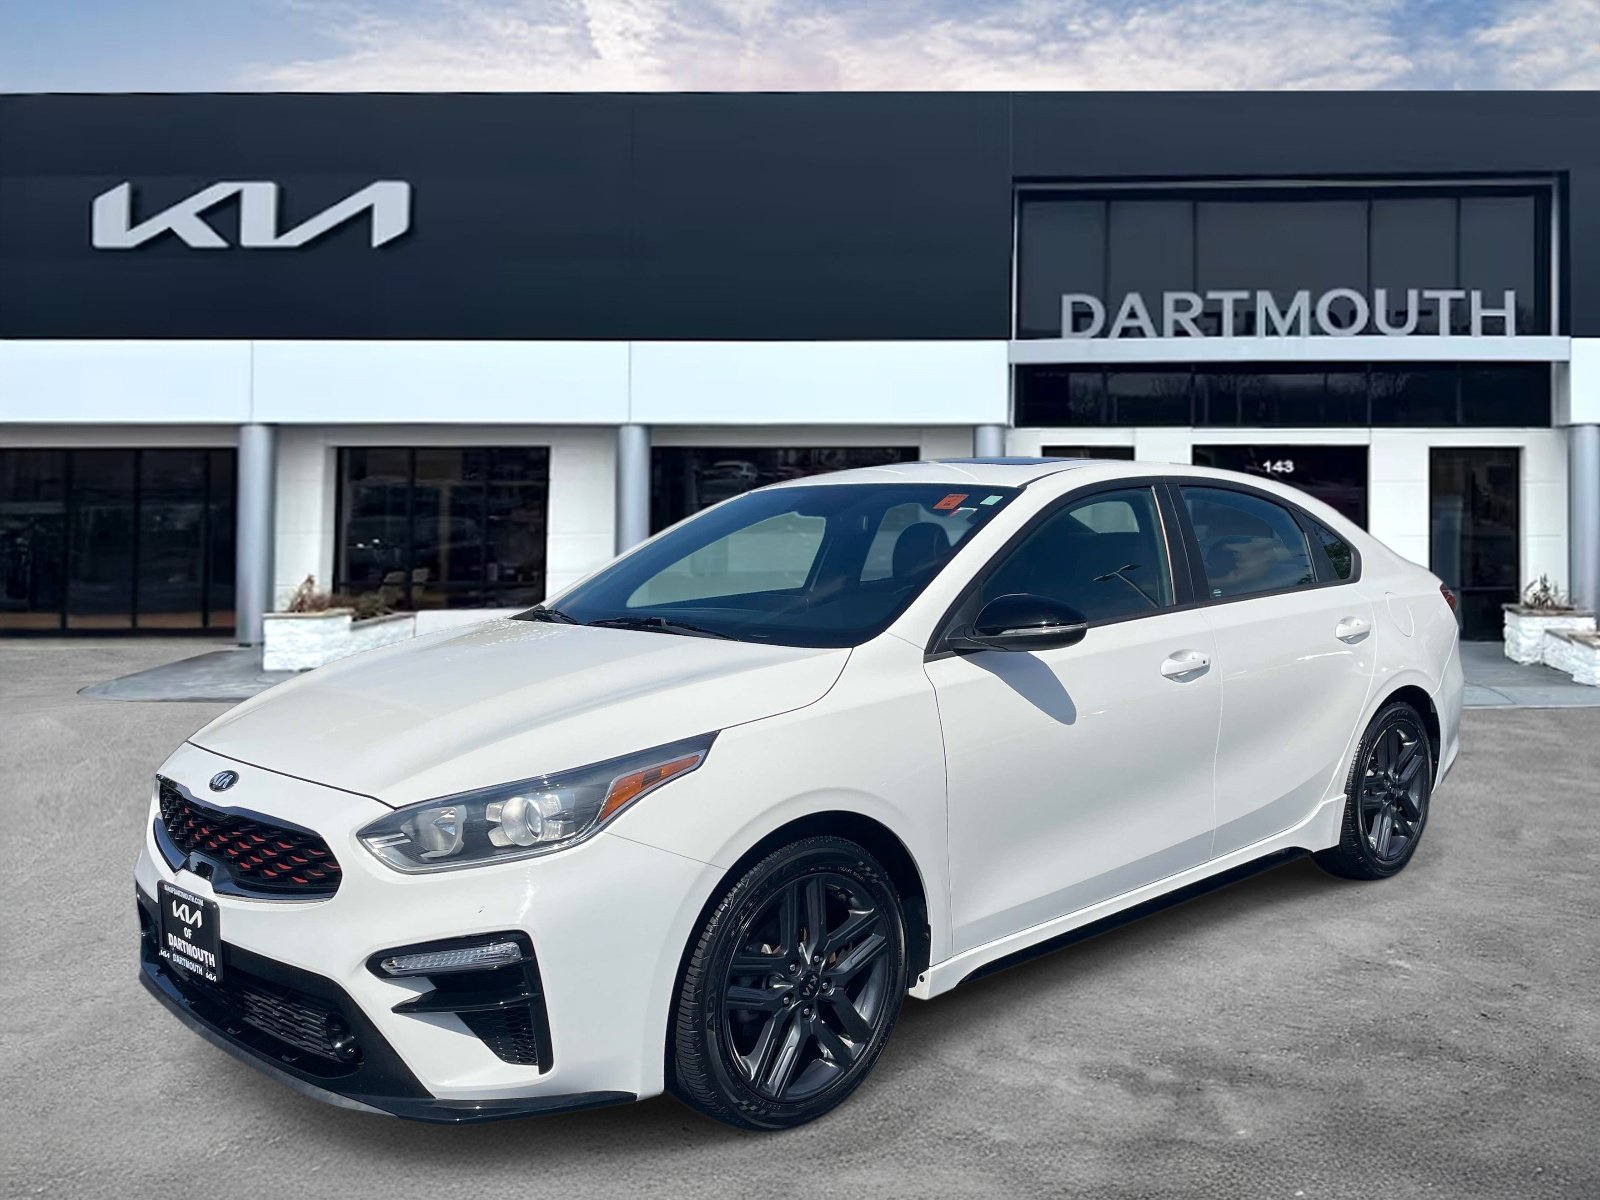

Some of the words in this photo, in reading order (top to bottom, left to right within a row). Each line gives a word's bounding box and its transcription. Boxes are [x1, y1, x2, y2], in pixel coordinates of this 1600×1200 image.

[91, 180, 412, 249] KIA
[1061, 287, 1518, 340] DARTMOUTH
[1262, 459, 1295, 474] 143
[212, 772, 233, 788] KIA
[172, 899, 203, 929] KIA
[184, 926, 193, 939] OF
[167, 932, 216, 968] DARTMOUTH
[172, 953, 203, 976] DARTMOUTH
[802, 974, 818, 996] KIA
